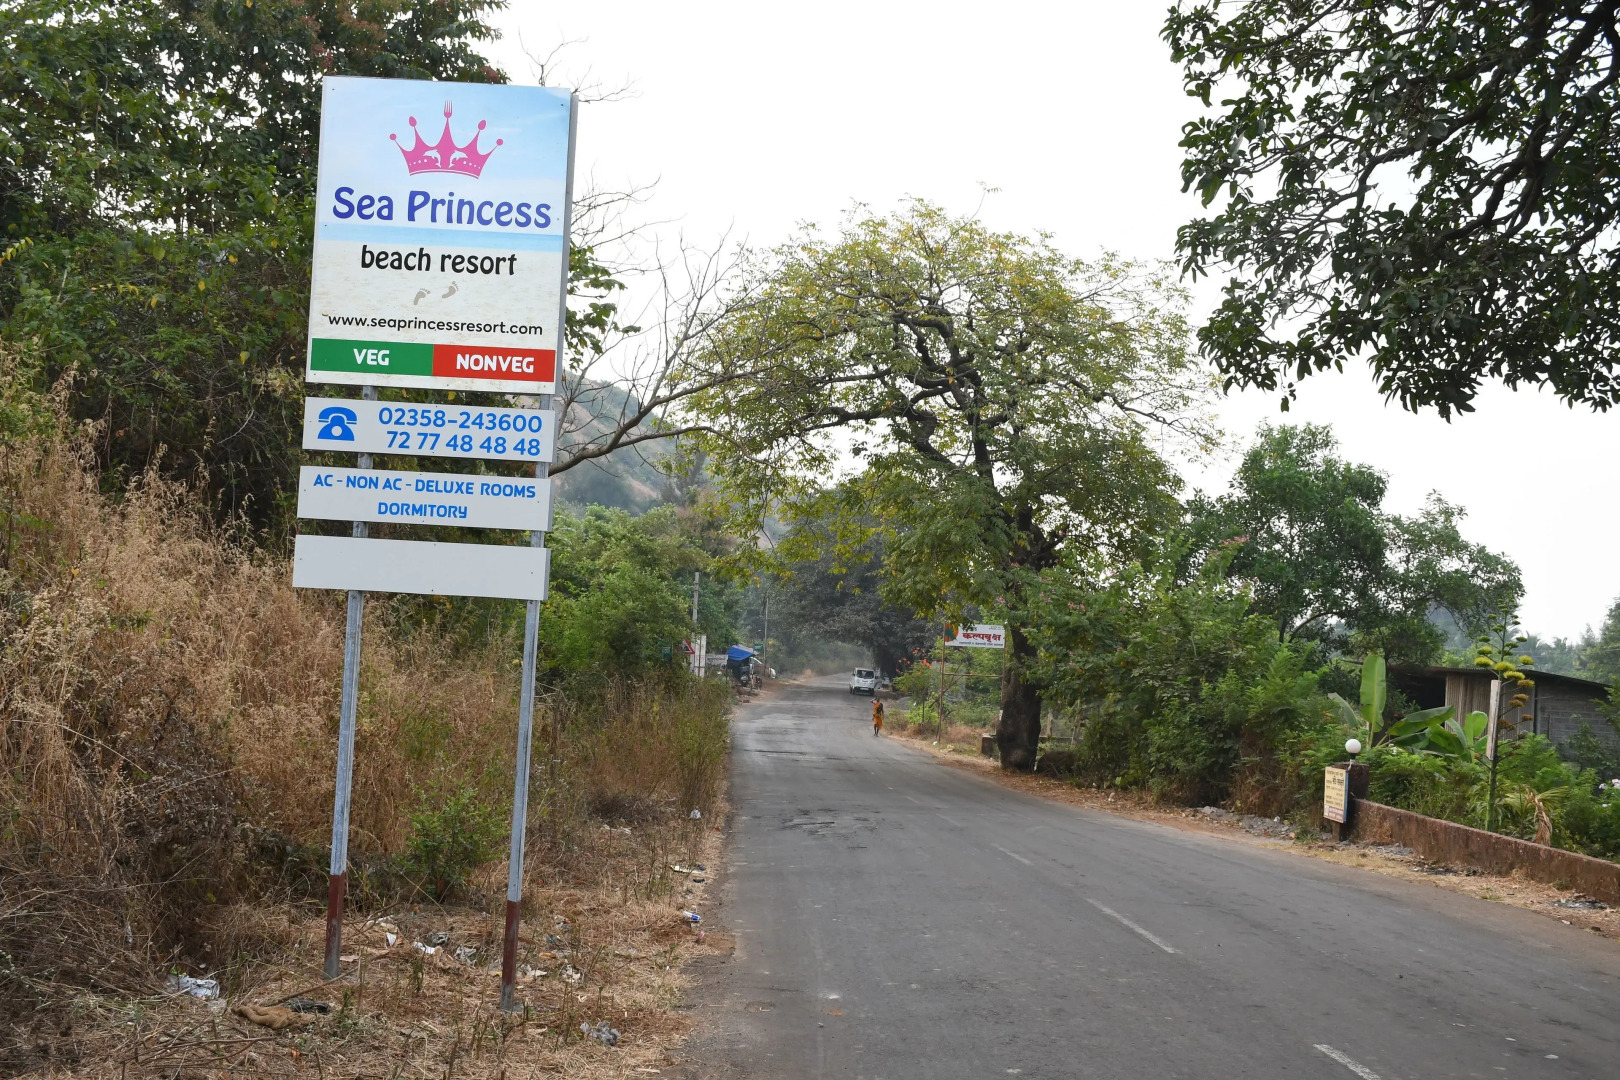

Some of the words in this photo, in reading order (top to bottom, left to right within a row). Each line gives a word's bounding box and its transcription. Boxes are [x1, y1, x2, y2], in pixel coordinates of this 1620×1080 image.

[332, 186, 394, 221] Sea
[407, 190, 552, 229] Princess
[360, 244, 431, 272] beach
[439, 252, 518, 276] resort
[328, 314, 543, 336] www.seaprincessresort.com
[353, 348, 390, 366] VEG
[456, 353, 535, 374] NONVEG
[378, 407, 543, 433] 02358-243600
[414, 478, 474, 495] DELUXE
[480, 482, 536, 498] ROOMS
[377, 502, 468, 519] DORMITORY
